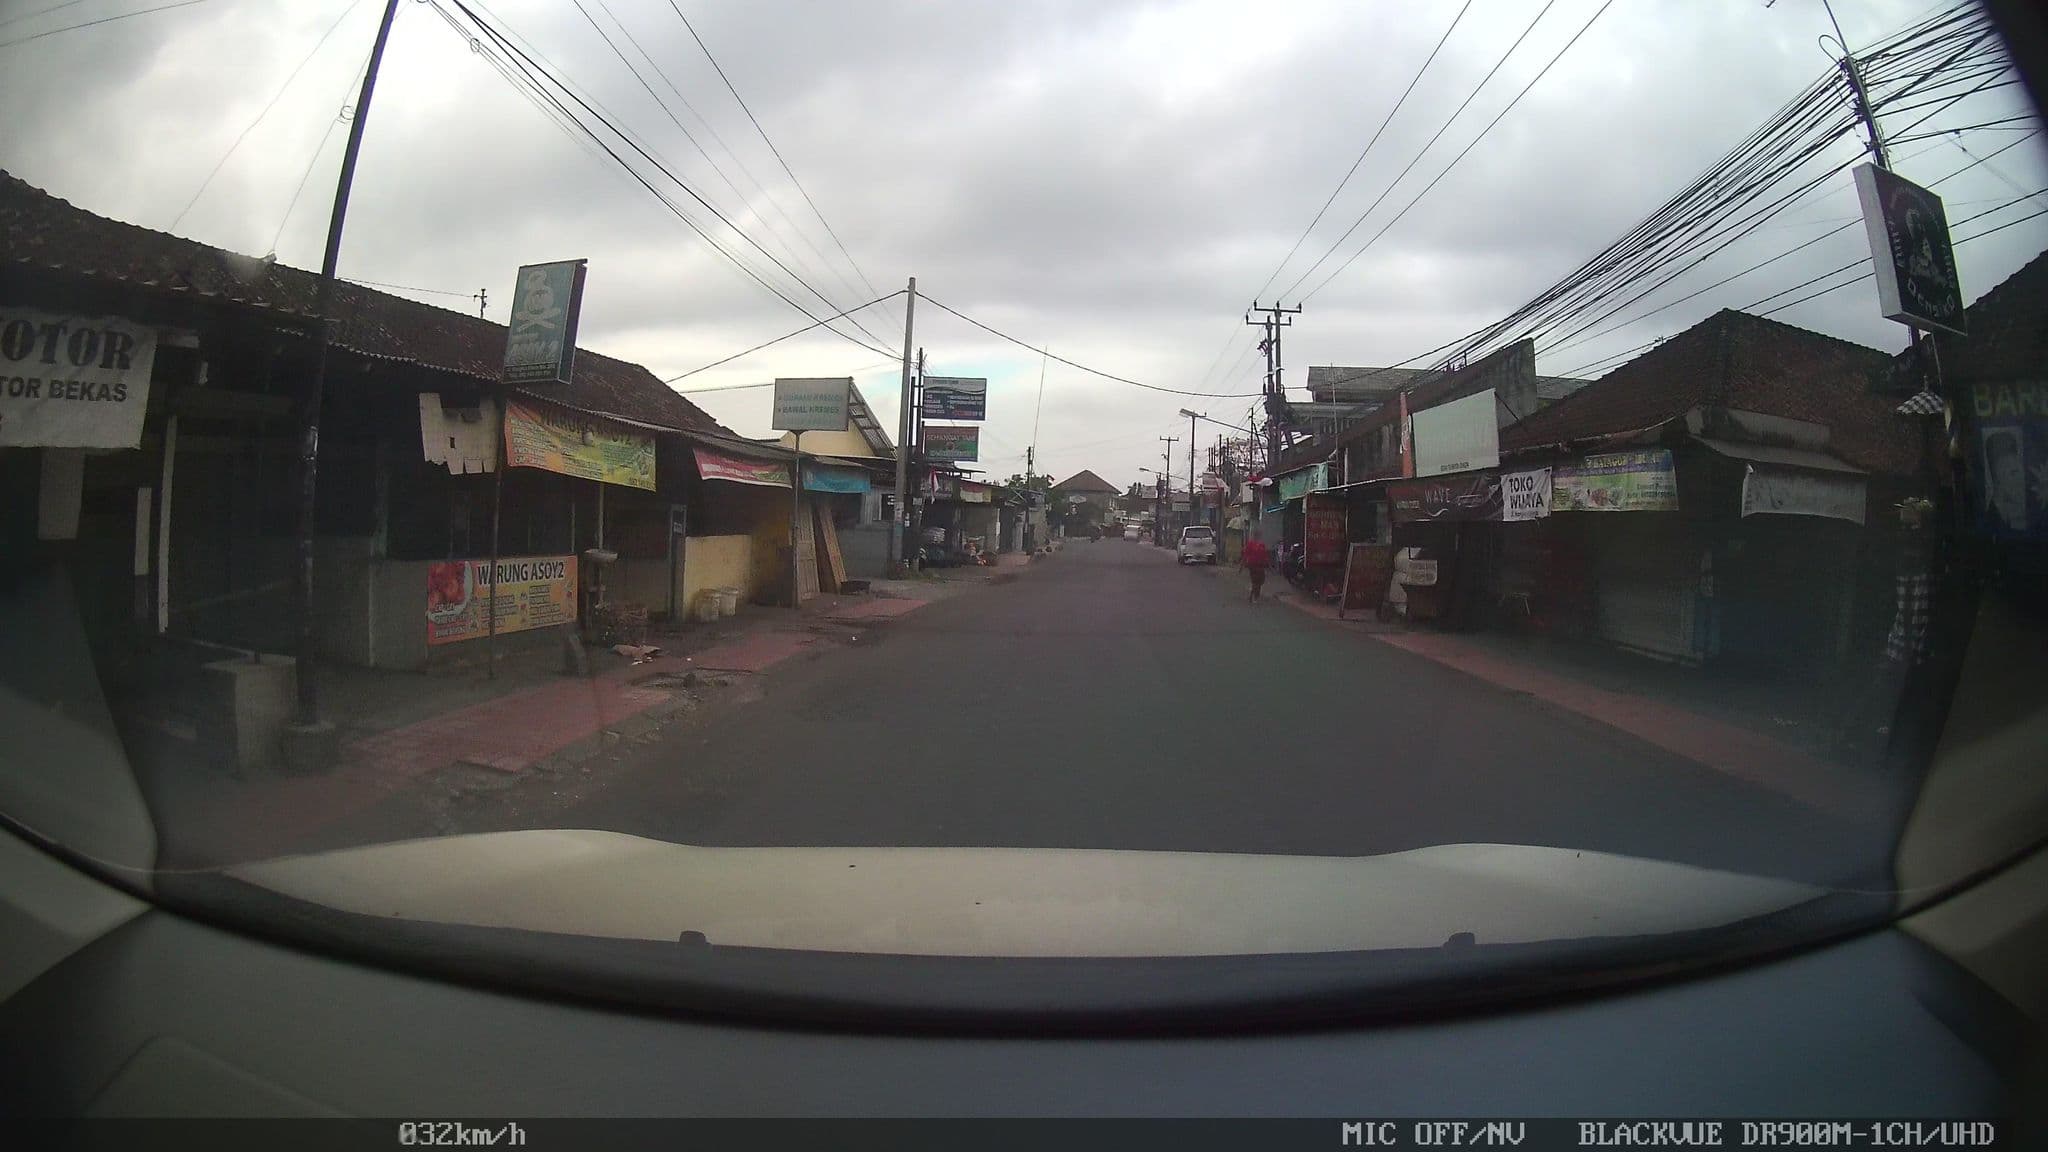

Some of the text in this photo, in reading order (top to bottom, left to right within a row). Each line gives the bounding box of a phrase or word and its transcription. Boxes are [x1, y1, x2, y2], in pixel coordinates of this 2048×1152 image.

[1, 320, 135, 370] OTOR
[48, 380, 128, 402] BEKAS
[1509, 476, 1533, 493] TOKO
[530, 561, 565, 582] ASOY2
